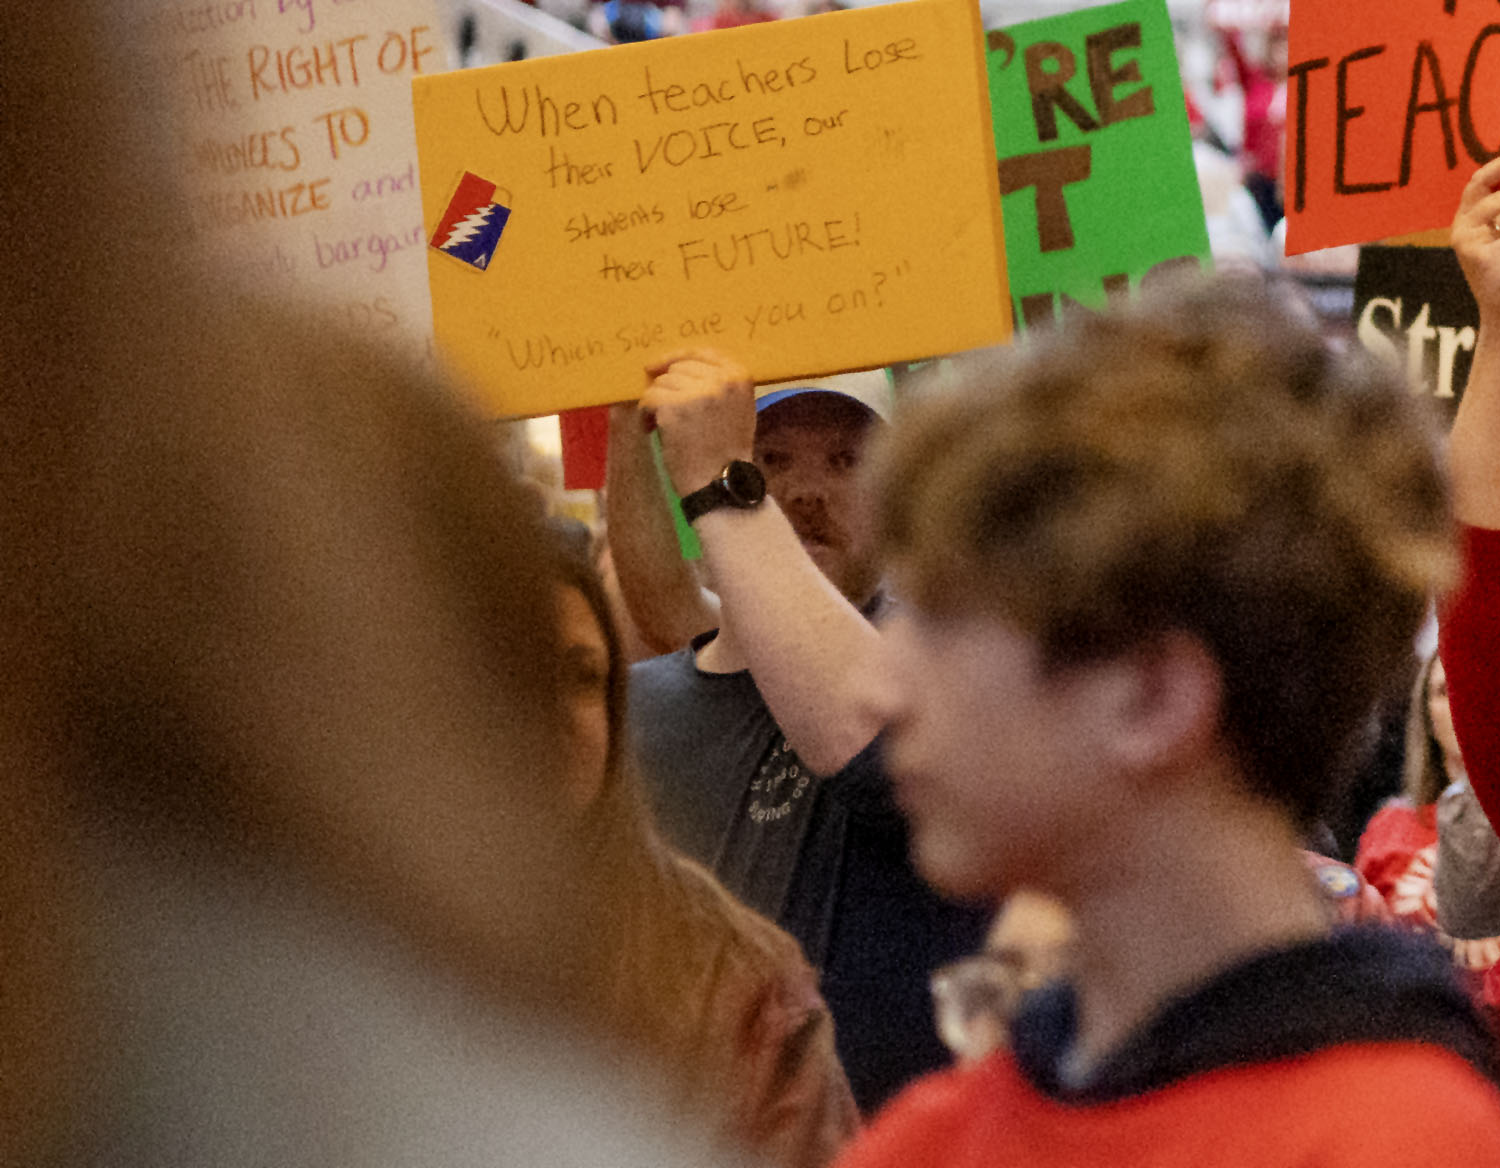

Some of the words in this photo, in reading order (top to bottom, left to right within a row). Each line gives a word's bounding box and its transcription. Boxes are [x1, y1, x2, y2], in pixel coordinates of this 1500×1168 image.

[247, 34, 370, 101] RIGHT
[376, 26, 433, 74] OF
[476, 84, 618, 138] When
[637, 55, 817, 115] teachers
[844, 35, 923, 75] Lose
[314, 106, 370, 160] TO
[545, 145, 614, 189] their
[633, 117, 788, 174] VOICE,
[803, 108, 849, 137] our
[351, 164, 415, 202] and
[687, 191, 751, 220] lose
[600, 253, 656, 282] their
[677, 212, 862, 280] FUTURE!
[678, 315, 725, 340] are
[743, 301, 806, 340] you
